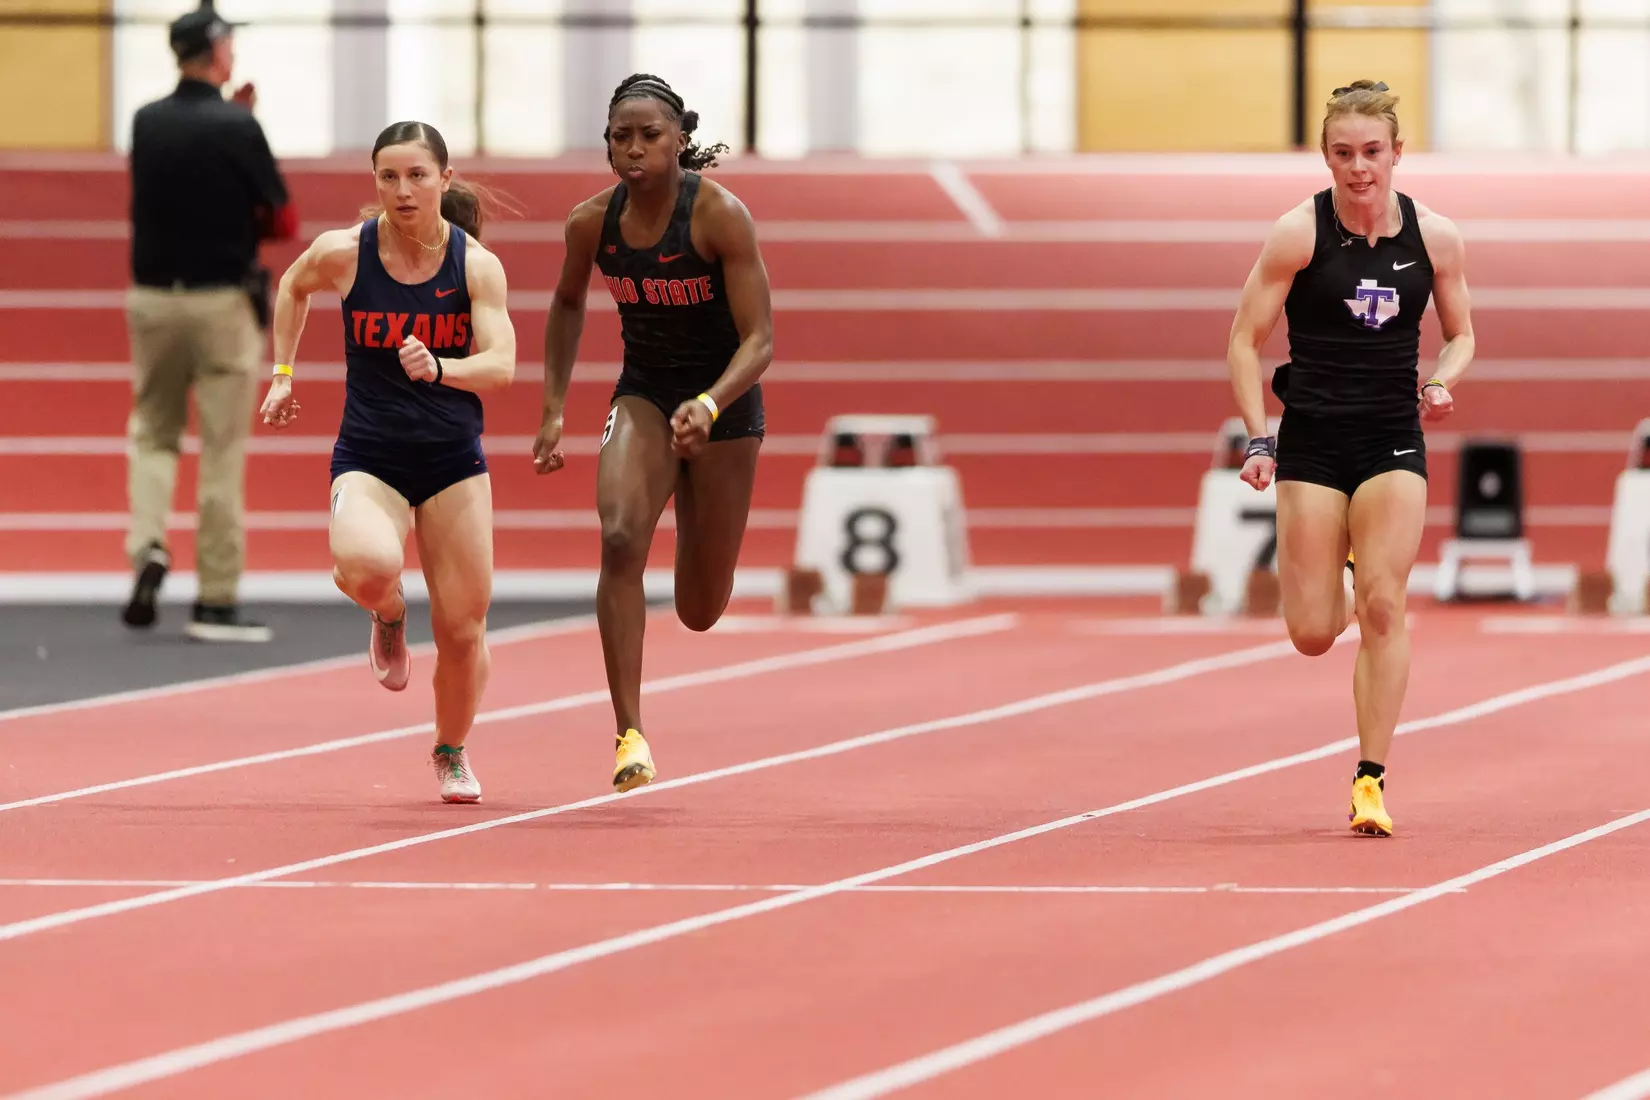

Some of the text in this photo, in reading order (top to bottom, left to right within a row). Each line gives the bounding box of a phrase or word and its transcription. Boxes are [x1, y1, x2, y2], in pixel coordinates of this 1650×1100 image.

[604, 275, 714, 306] HIO STATE
[1356, 286, 1397, 328] T
[351, 310, 470, 349] TEXANS
[841, 506, 899, 577] 8
